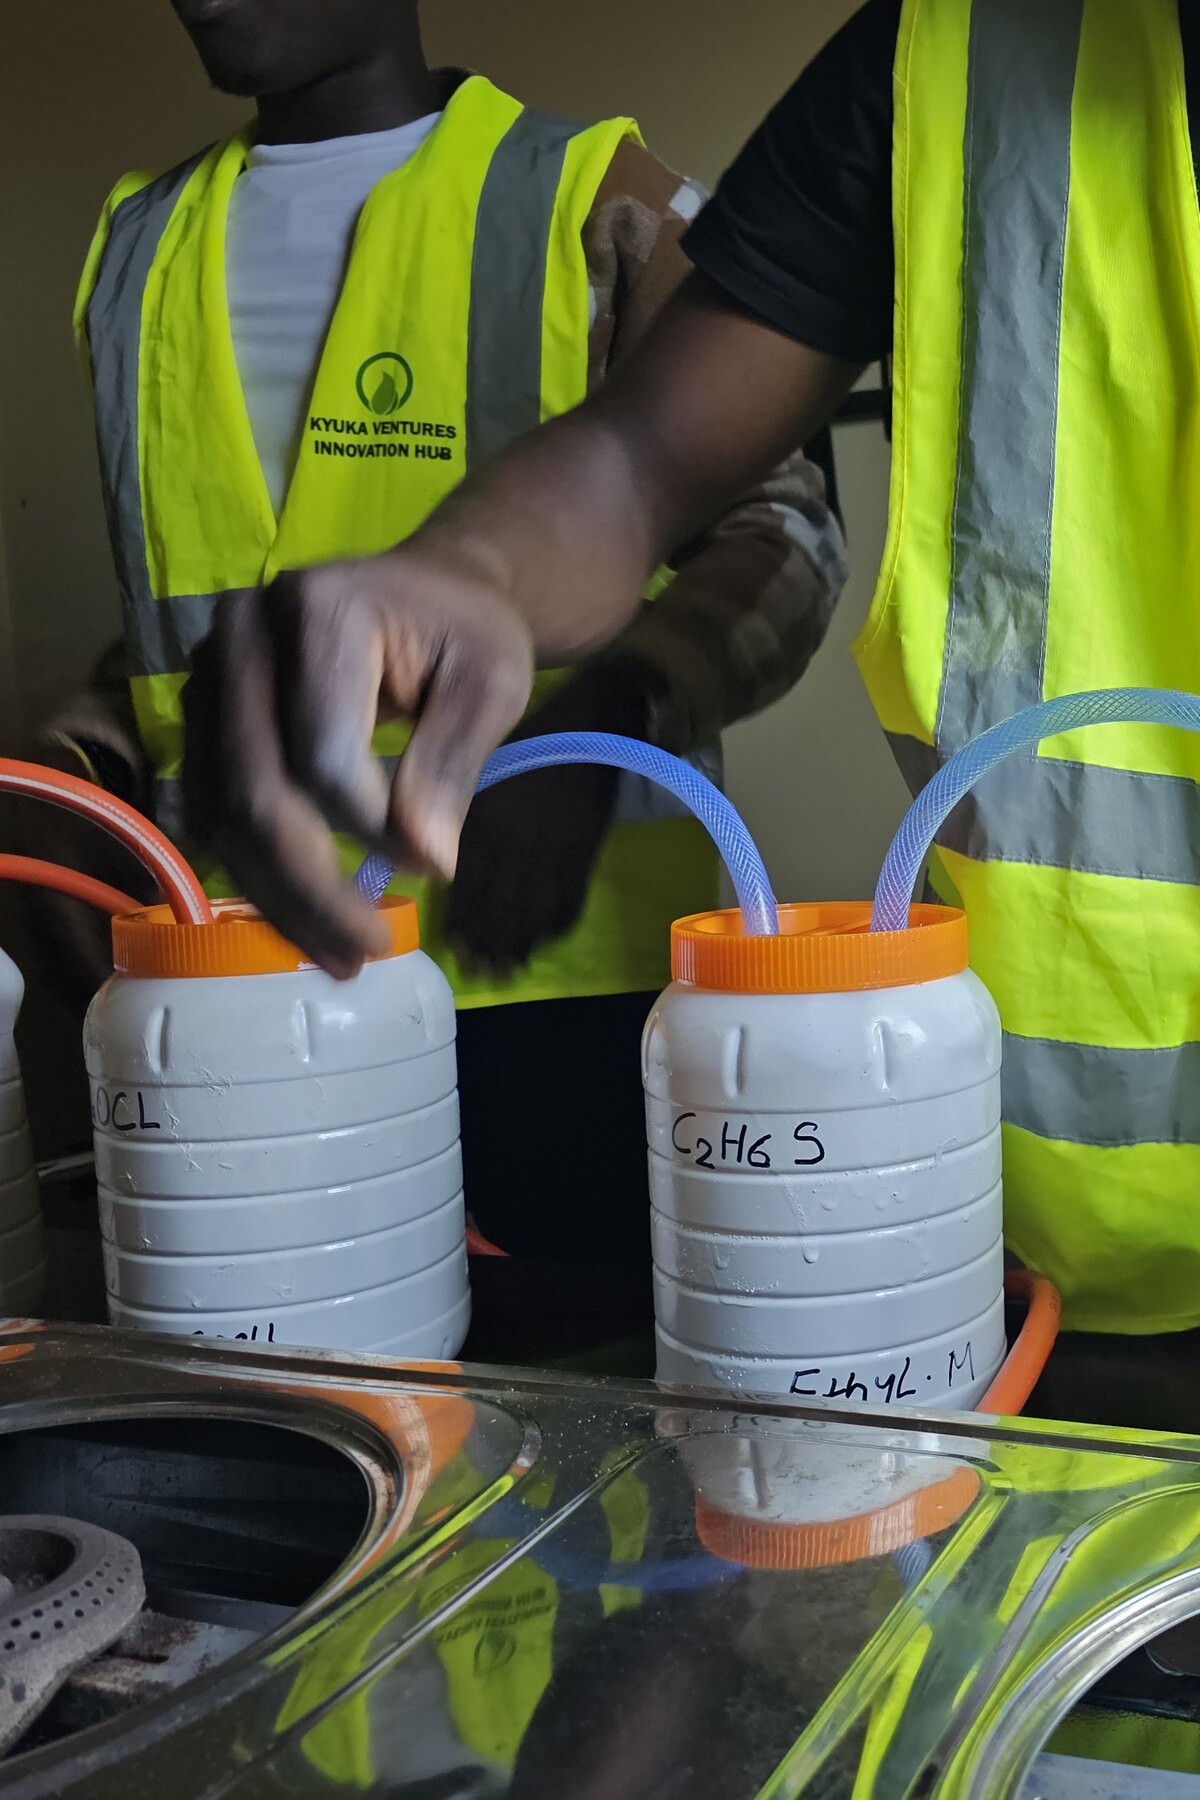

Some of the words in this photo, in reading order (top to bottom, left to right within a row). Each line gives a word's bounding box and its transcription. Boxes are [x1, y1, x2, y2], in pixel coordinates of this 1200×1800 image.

[310, 417, 368, 435] KYUKA
[373, 421, 456, 439] VENTURES
[315, 440, 409, 458] INNOVATION
[414, 444, 452, 460] HUB
